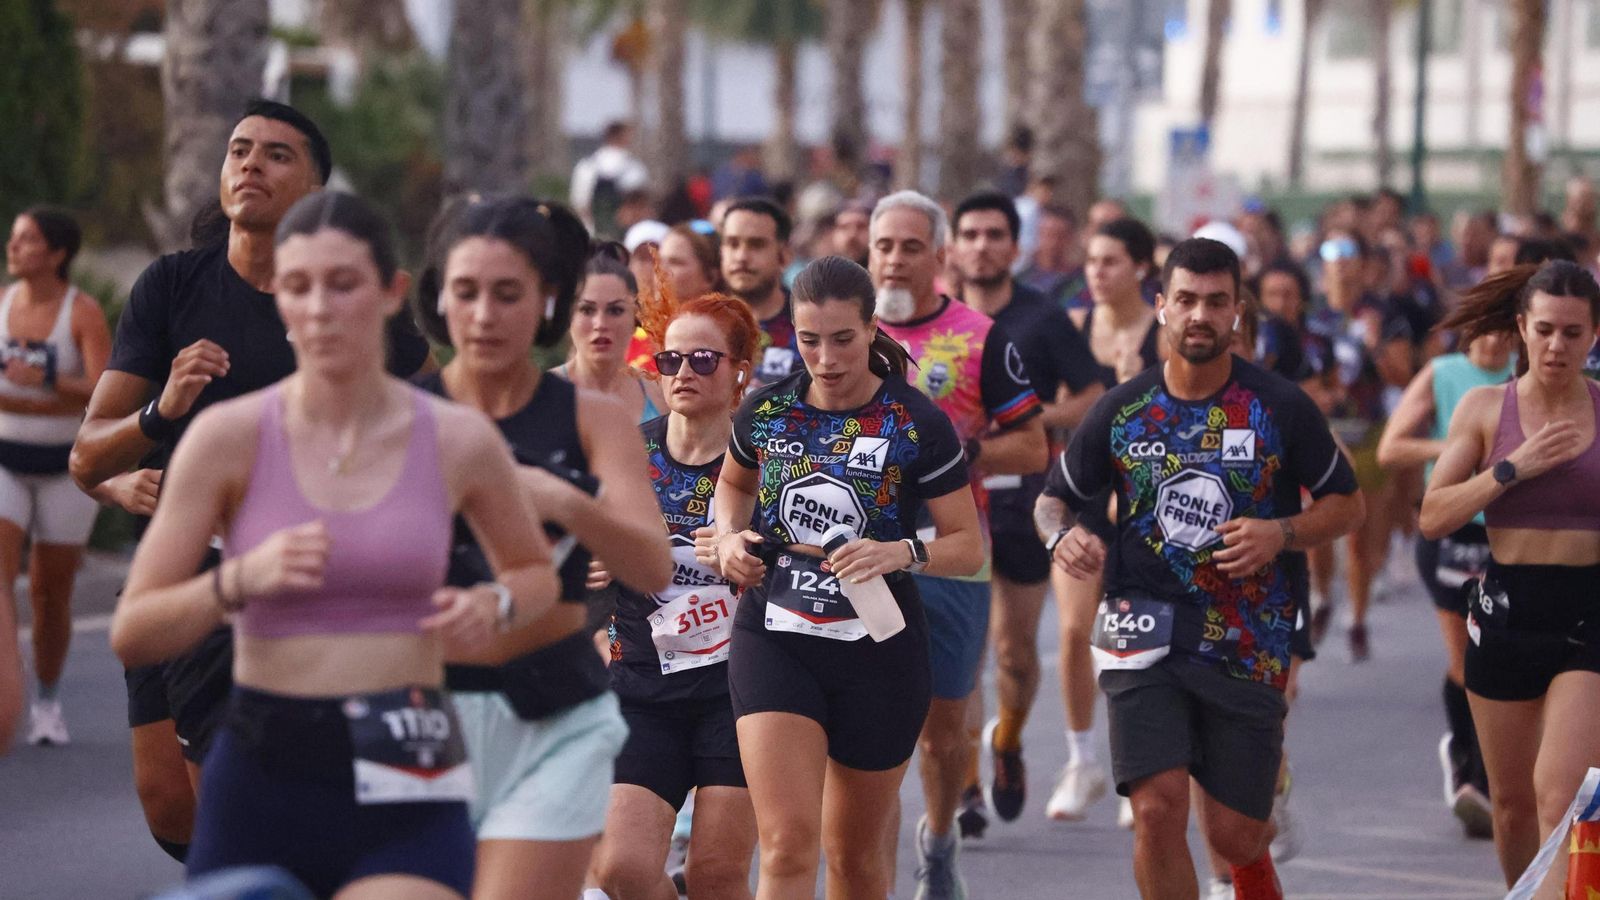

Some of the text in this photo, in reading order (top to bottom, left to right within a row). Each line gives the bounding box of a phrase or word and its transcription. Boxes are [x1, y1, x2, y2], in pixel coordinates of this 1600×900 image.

[850, 451, 877, 468] AXA
[1223, 445, 1249, 458] AXA
[791, 492, 856, 527] PONLE
[1167, 489, 1224, 518] PONLE
[790, 569, 848, 598] 124
[674, 598, 729, 635] 3151
[1103, 613, 1156, 633] 1340
